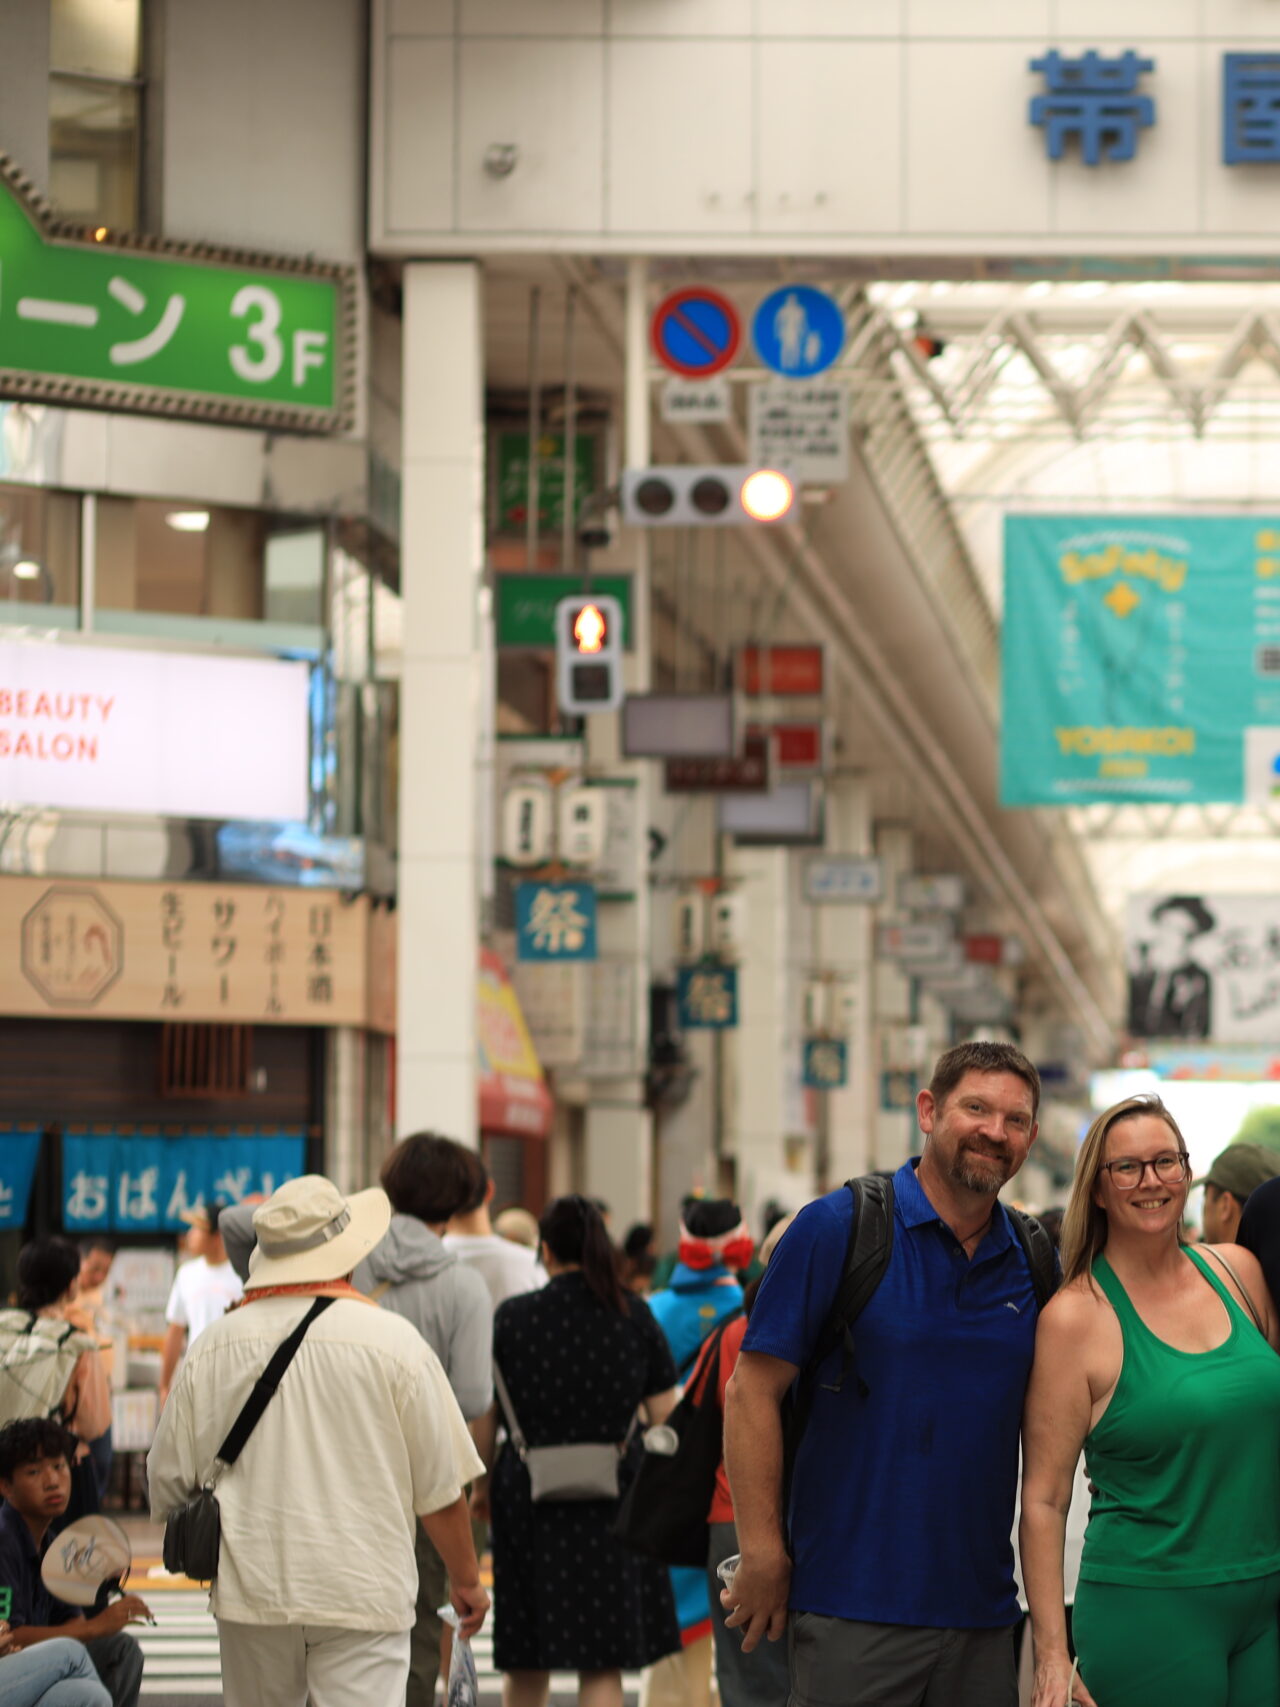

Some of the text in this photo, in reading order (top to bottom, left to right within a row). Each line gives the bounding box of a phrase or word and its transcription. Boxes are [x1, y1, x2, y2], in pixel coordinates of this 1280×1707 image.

[228, 284, 328, 388] 3F
[211, 897, 238, 1005] サワー
